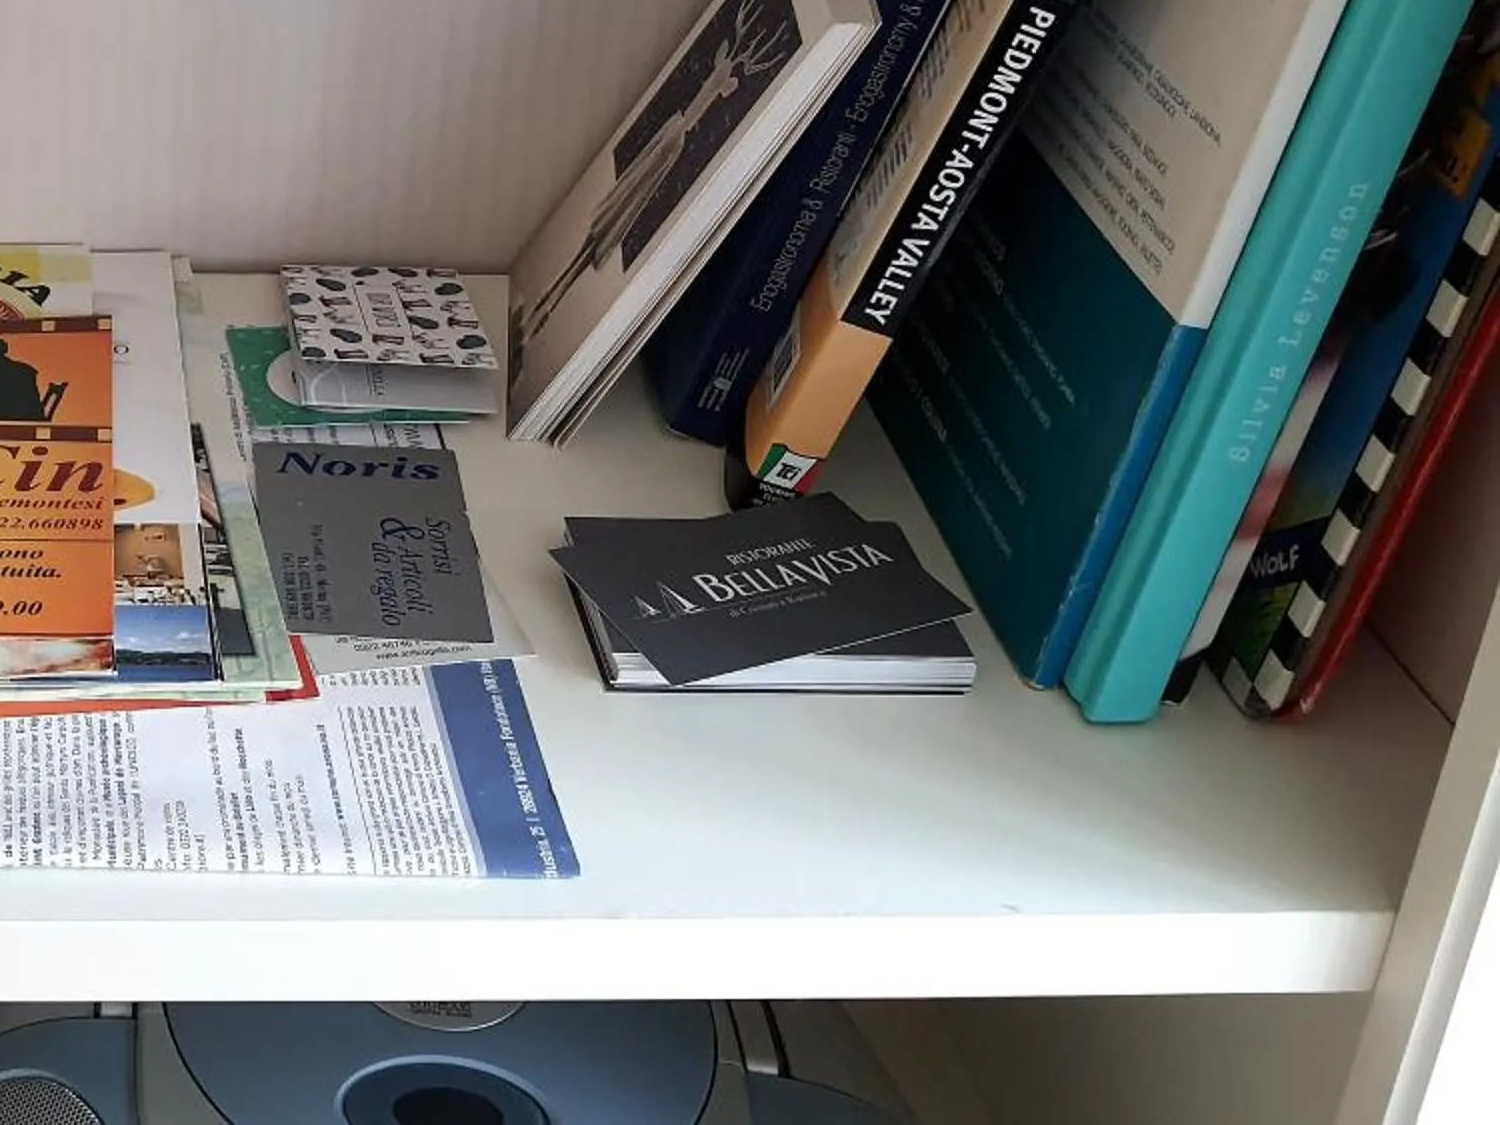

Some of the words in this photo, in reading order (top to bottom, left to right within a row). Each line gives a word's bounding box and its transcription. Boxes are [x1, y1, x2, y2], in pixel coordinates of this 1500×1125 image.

[910, 6, 1056, 244] PIEDMONT-AOSTA
[863, 237, 931, 327] VALLEY
[1227, 364, 1288, 464] Silvia
[1277, 179, 1370, 349] Levenson
[277, 451, 440, 481] Noris
[370, 542, 398, 563] da
[379, 516, 425, 541] &
[425, 516, 456, 577] Sorrisi
[725, 536, 817, 566] RISTORANTE
[369, 567, 408, 627] regalo
[396, 544, 433, 615] Articoli
